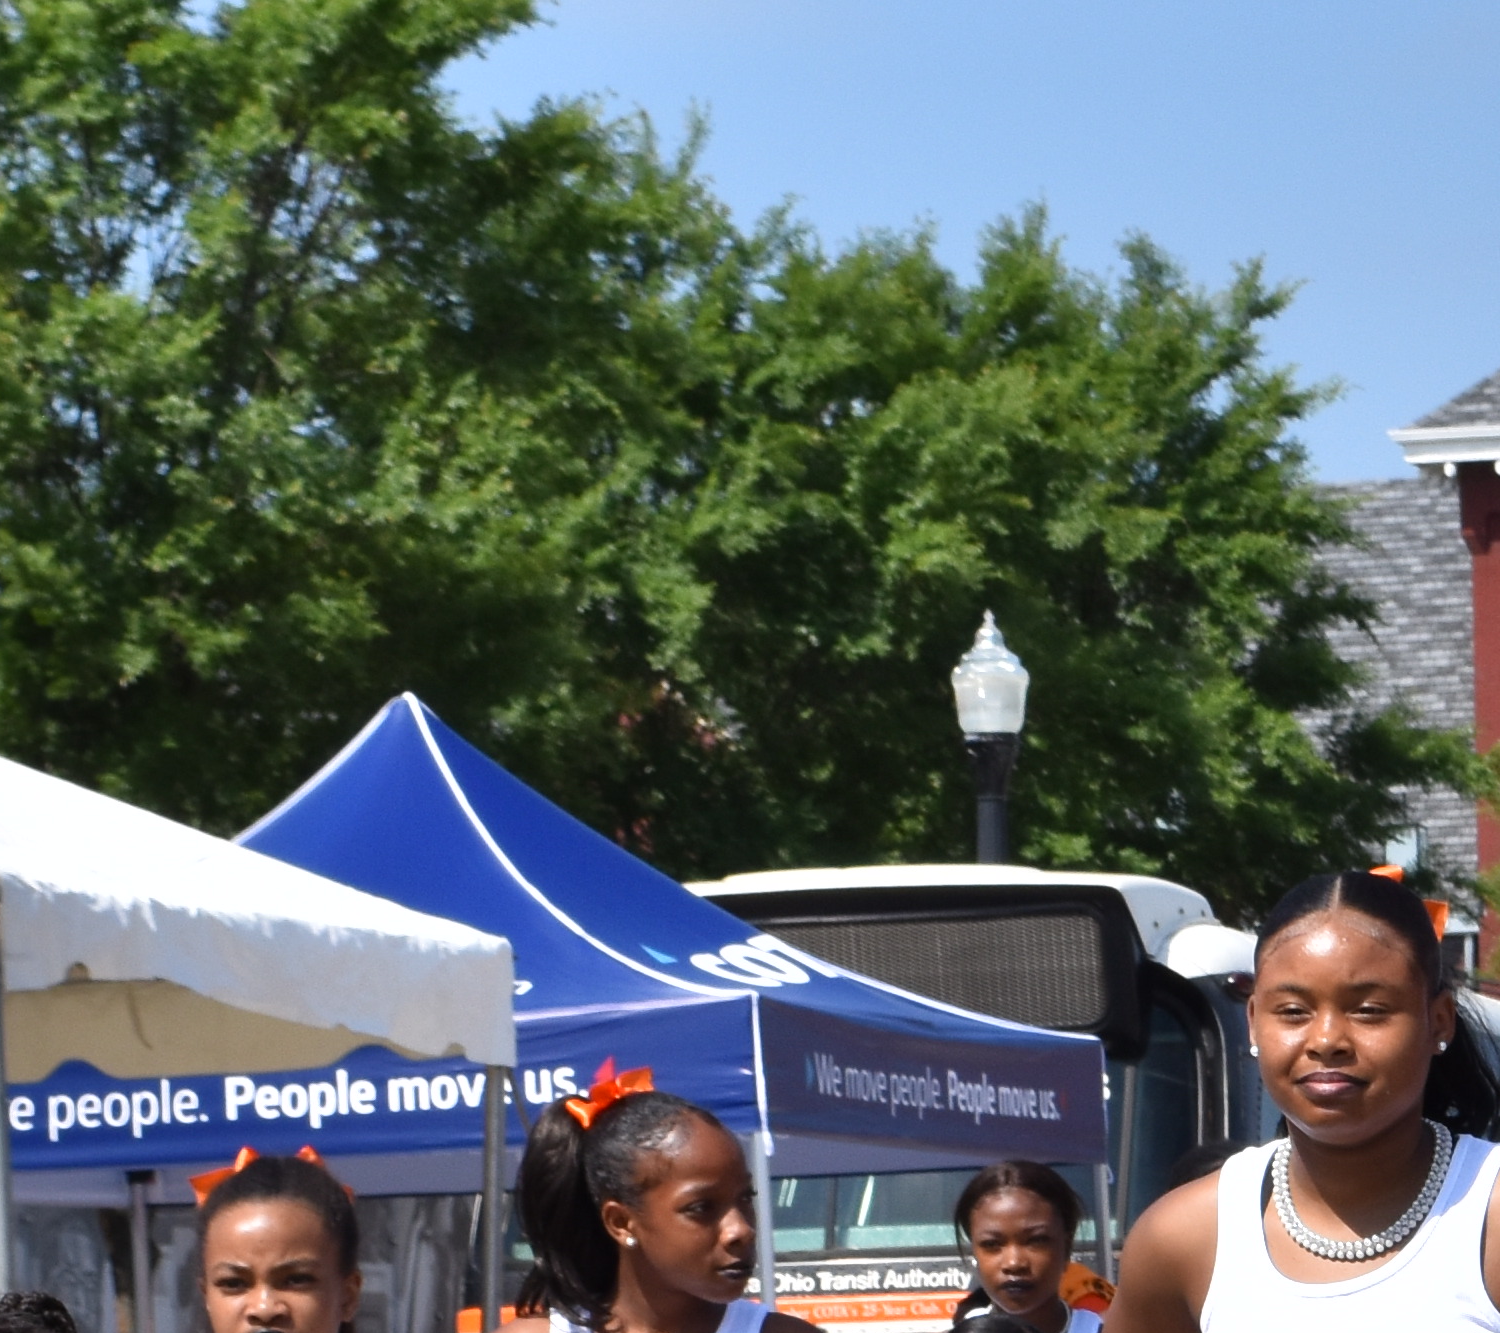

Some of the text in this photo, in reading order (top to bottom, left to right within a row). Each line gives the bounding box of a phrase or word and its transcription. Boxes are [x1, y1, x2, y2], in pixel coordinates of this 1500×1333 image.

[48, 1078, 209, 1142] people.
[224, 1068, 376, 1129] People
[524, 1066, 589, 1104] us.
[813, 1051, 1062, 1125] We move people. People move us.
[816, 1269, 881, 1291] Transit
[883, 1267, 972, 1290] Authority
